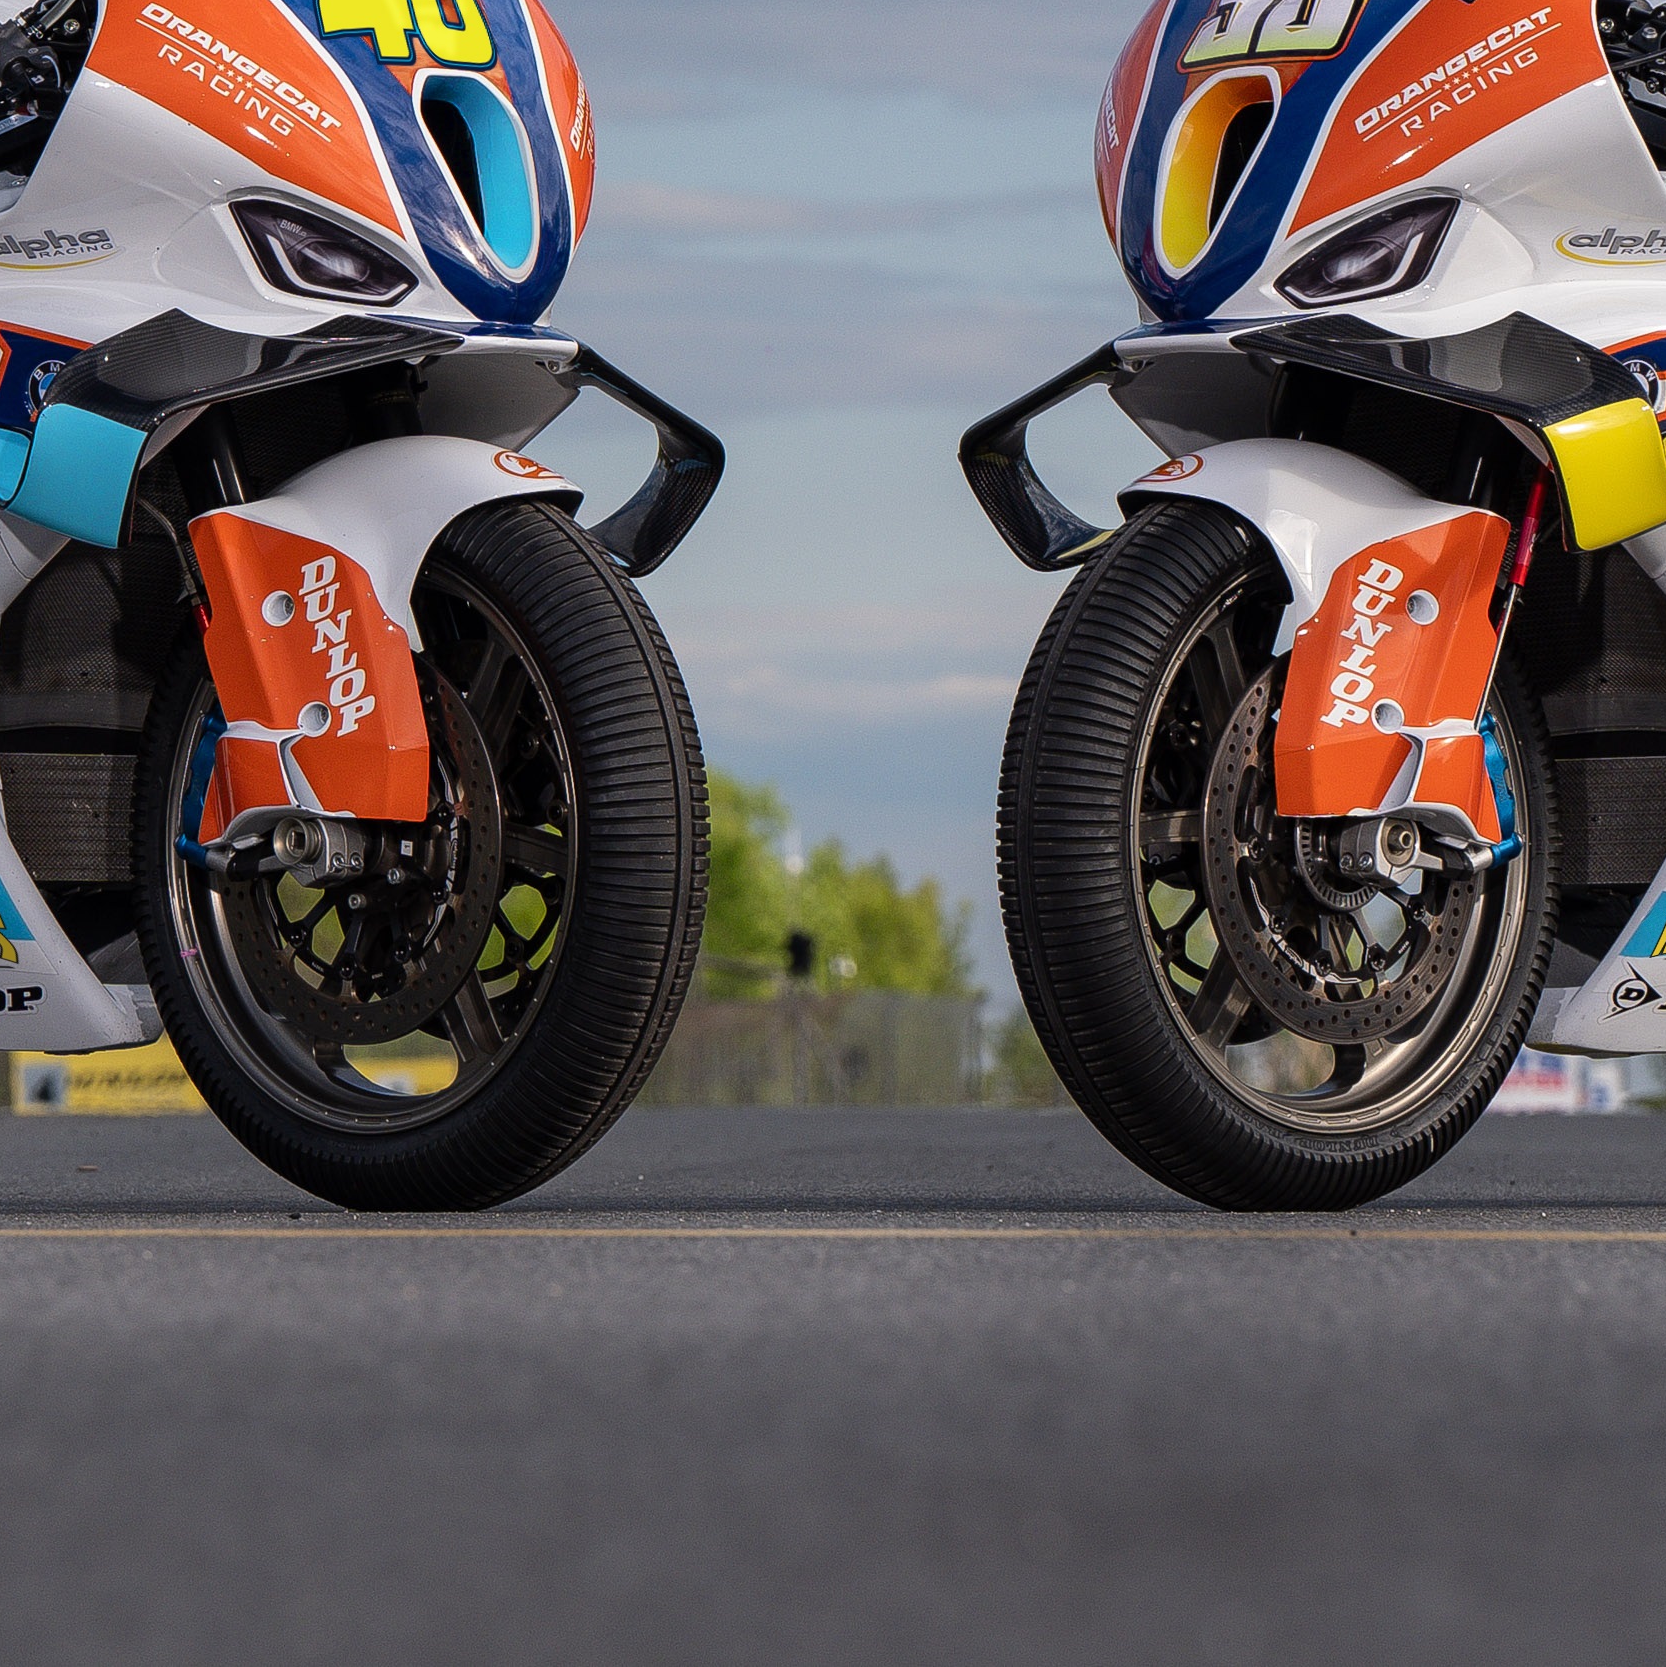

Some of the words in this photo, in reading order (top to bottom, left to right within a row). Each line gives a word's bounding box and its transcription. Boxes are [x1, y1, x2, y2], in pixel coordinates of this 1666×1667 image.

[141, 3, 342, 129] ORANGECAT
[158, 44, 295, 136] RACING
[1354, 7, 1552, 135] ORANGECAT
[1400, 47, 1539, 137] RACING
[40, 243, 114, 259] RACING
[299, 556, 376, 737] DUNLOP
[1320, 558, 1404, 728] DUNLOP
